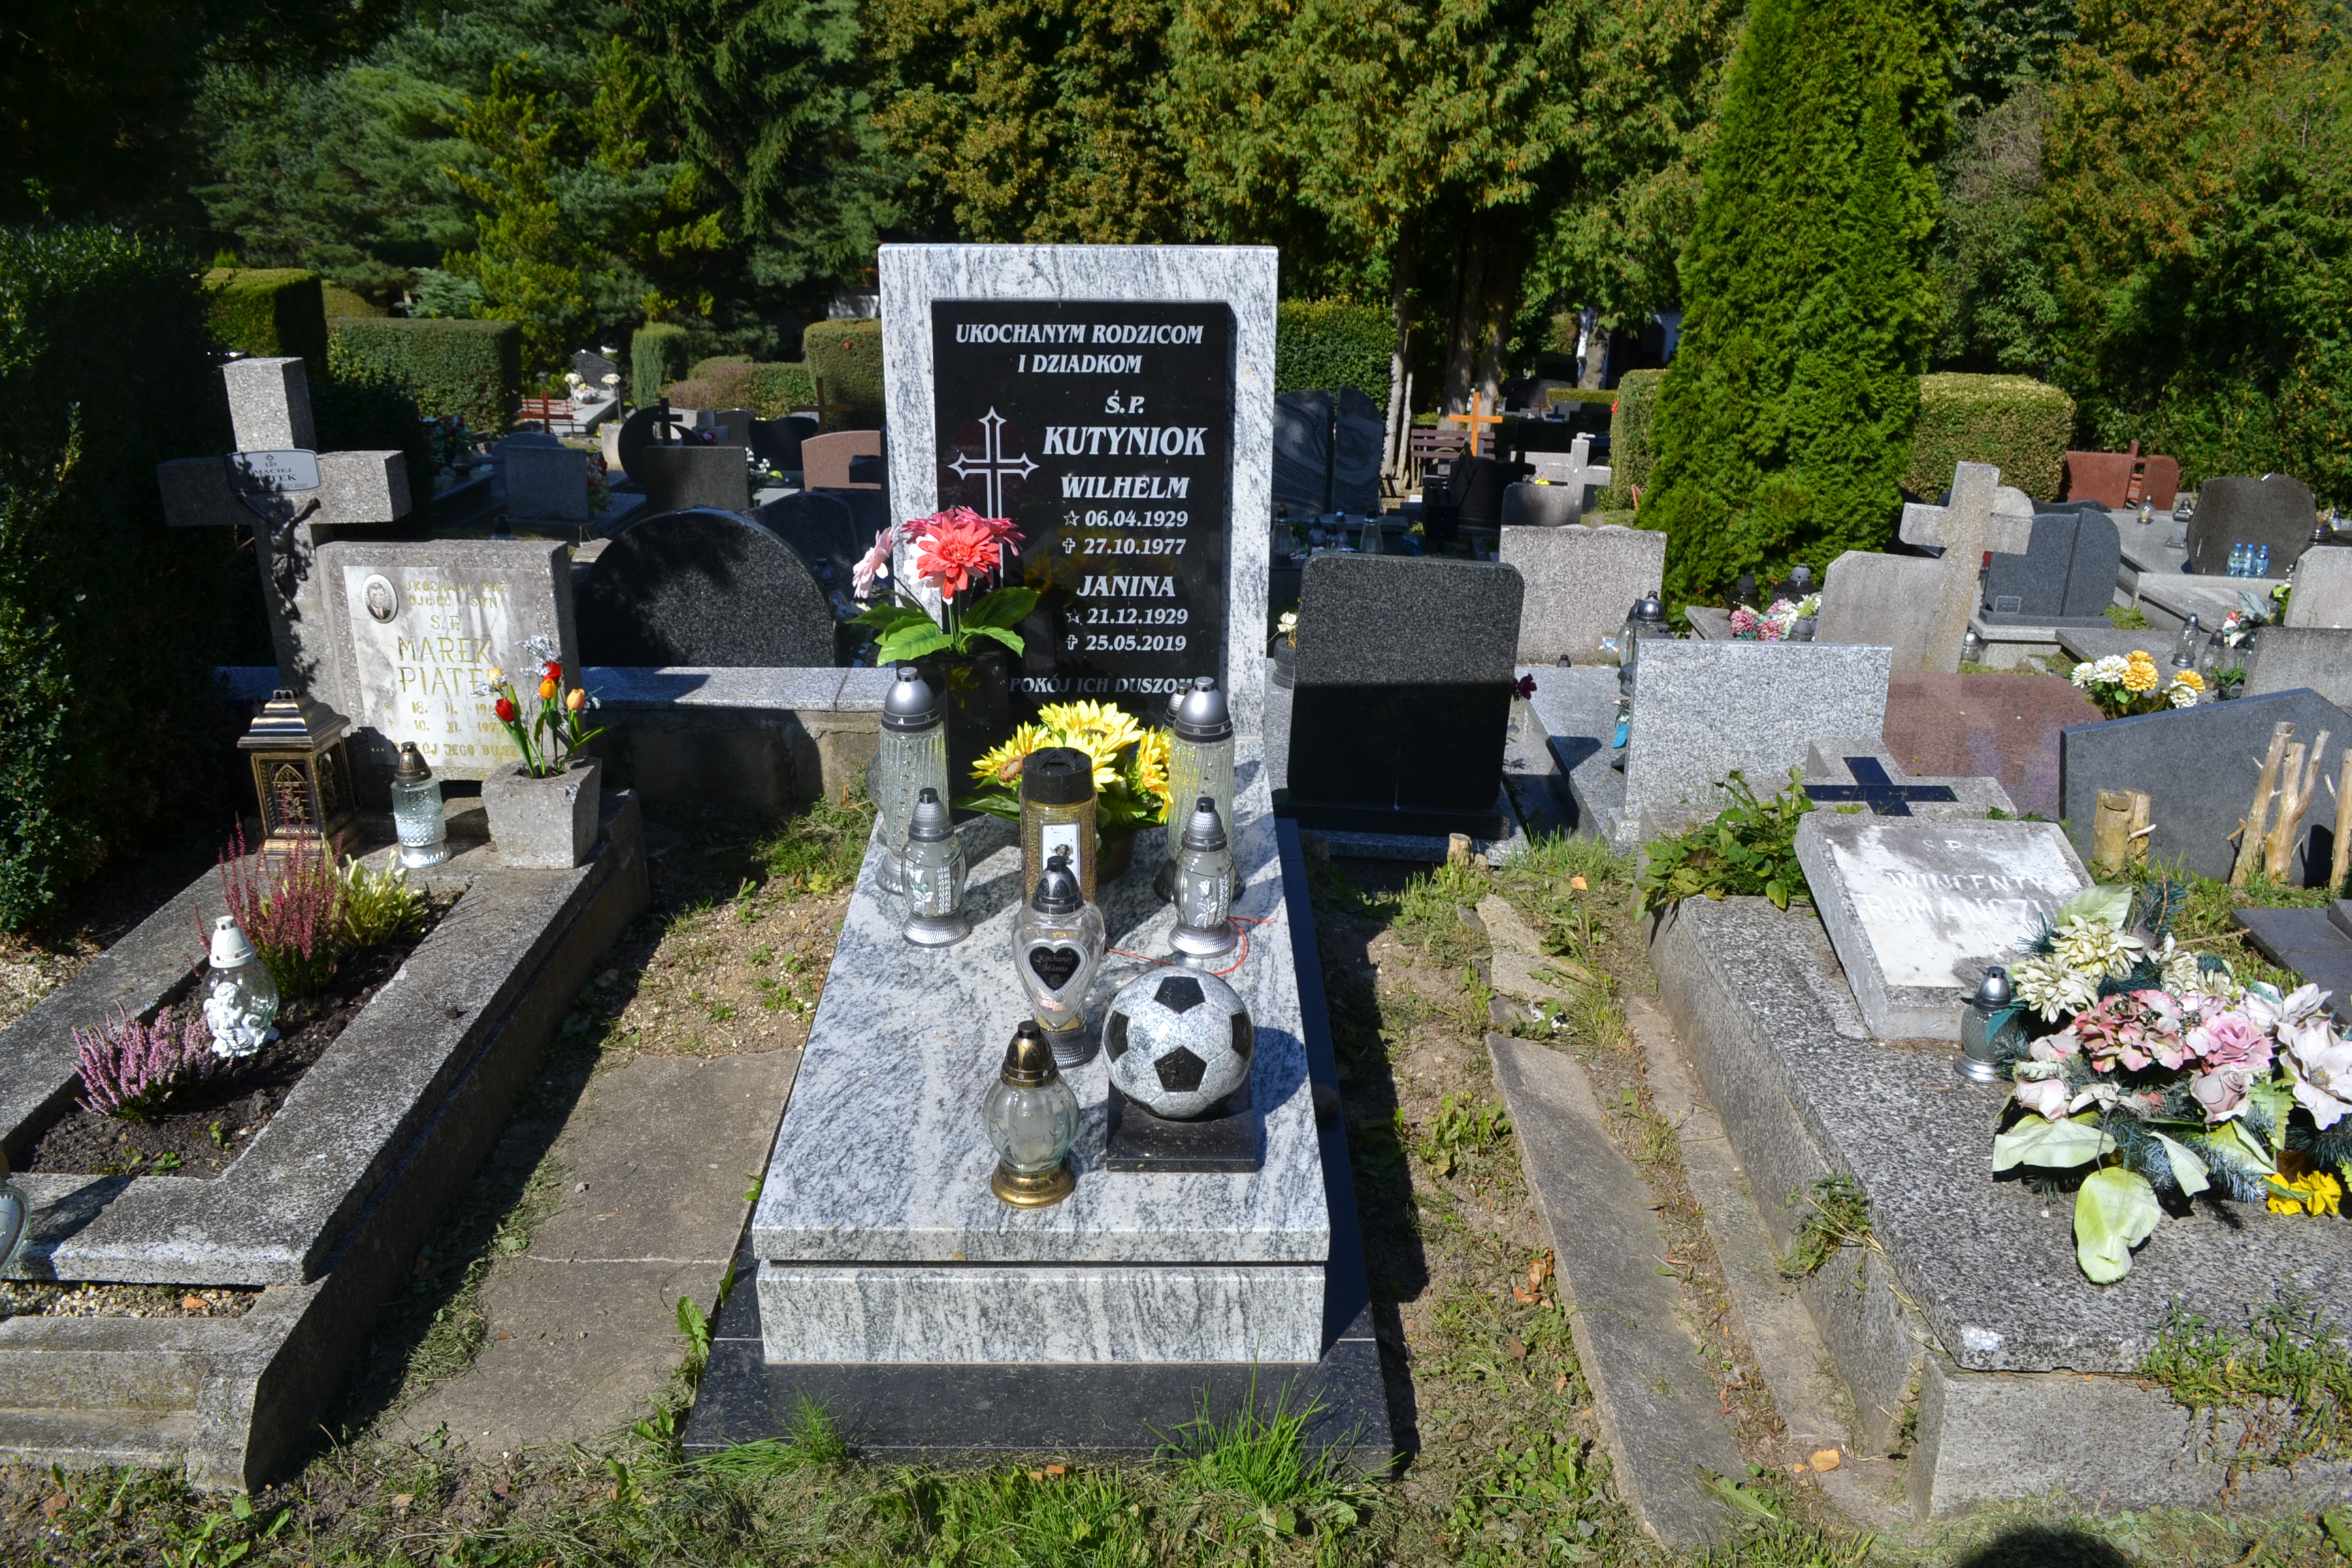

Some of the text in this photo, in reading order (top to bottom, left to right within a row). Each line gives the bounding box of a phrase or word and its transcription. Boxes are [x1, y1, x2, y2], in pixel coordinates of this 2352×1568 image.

[956, 324, 1204, 344] UKOCHANYM RODZICOM
[1017, 355, 1143, 374] I DZIADKOM
[1042, 426, 1209, 456] KUTYNIOK
[1060, 476, 1190, 499] WILHELM
[1085, 509, 1188, 527] 06.04.1929
[1083, 538, 1187, 555] 27.10.1977
[1076, 575, 1176, 597] JANINA
[470, 597, 499, 608] SYN
[1086, 608, 1188, 625] 21.12.1929
[397, 635, 492, 665] MAREK
[1085, 635, 1187, 651] 25.05.2019
[397, 666, 497, 699] PIĄTE
[1010, 673, 1070, 693] POKÓJ
[1076, 678, 1108, 693] ICH
[443, 743, 476, 757] JEGO
[482, 744, 519, 758] DUSZ
[1885, 871, 2047, 892] WINCENTY
[1037, 953, 1073, 964] Kochanej
[1042, 964, 1069, 973] Mamie
